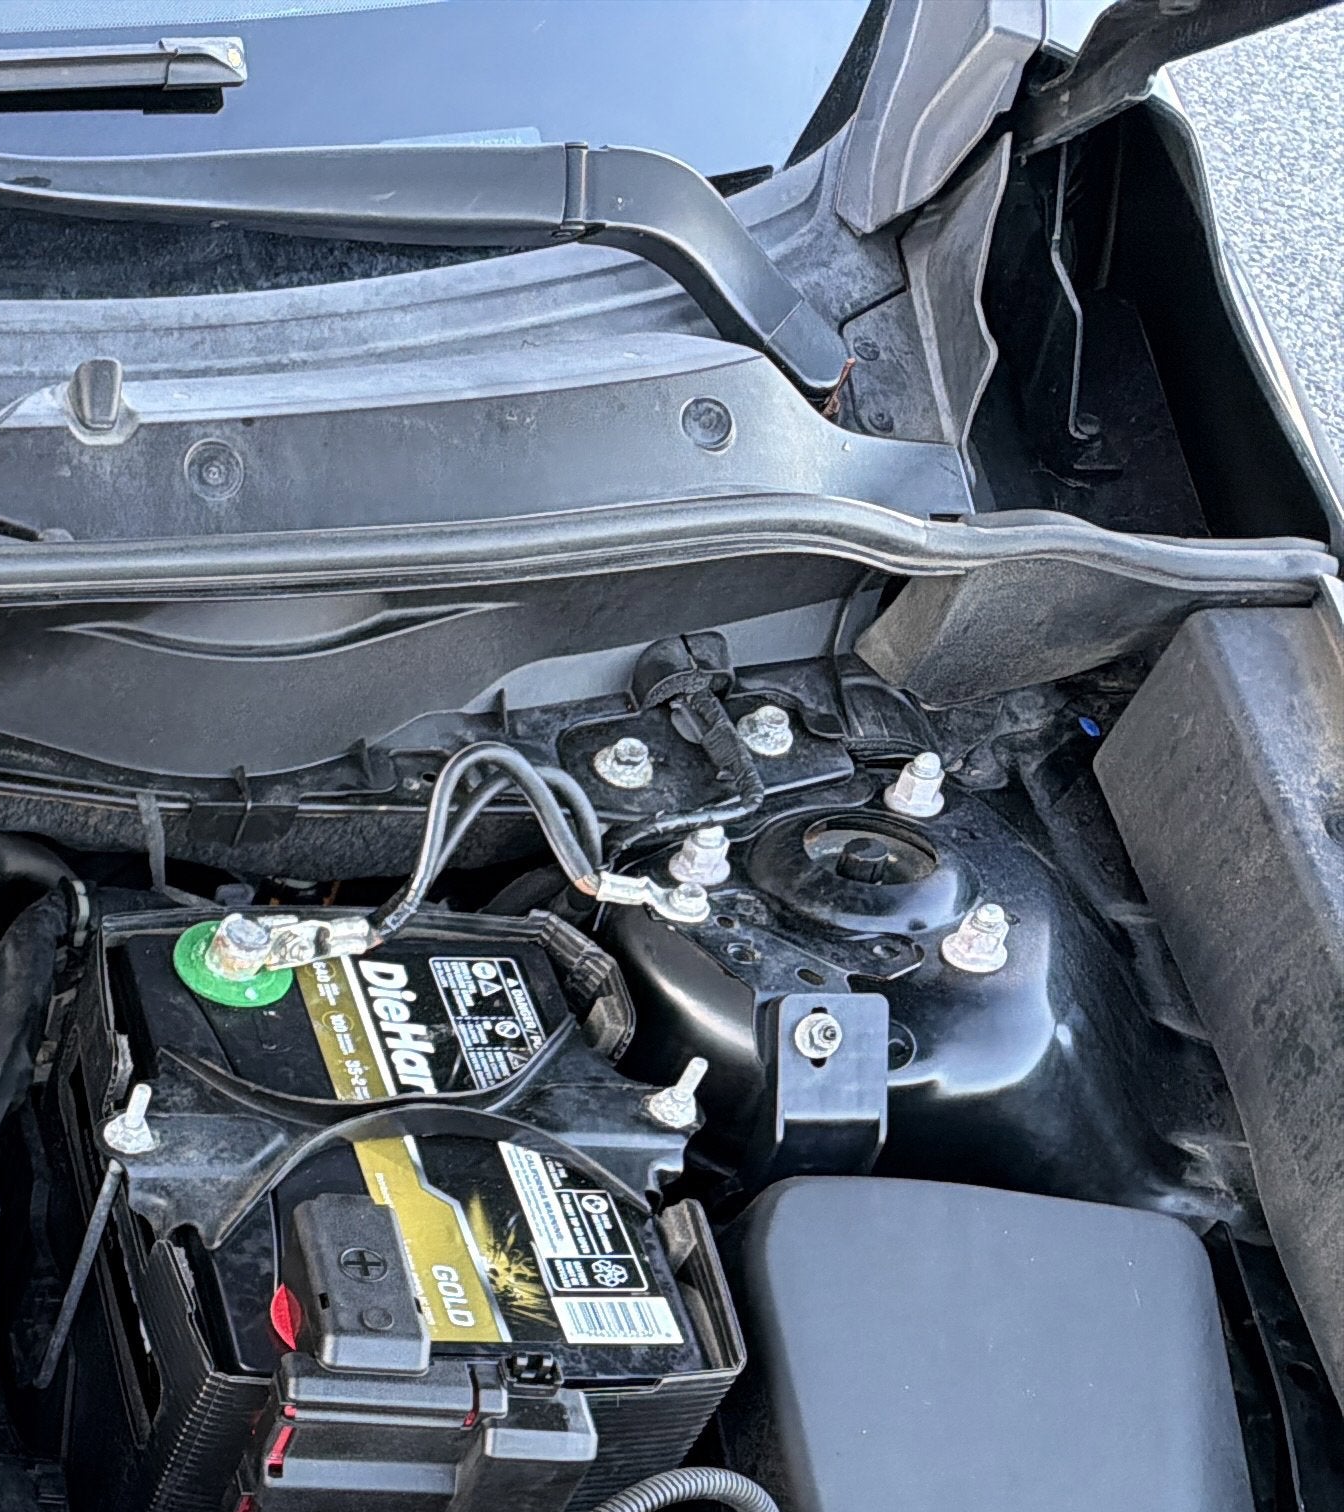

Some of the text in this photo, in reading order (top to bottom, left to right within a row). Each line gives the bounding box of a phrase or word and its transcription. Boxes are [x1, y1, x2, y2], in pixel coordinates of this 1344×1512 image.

[358, 960, 438, 1095] DieHar
[511, 988, 537, 1029] DANGER
[431, 1264, 475, 1327] GOLD
